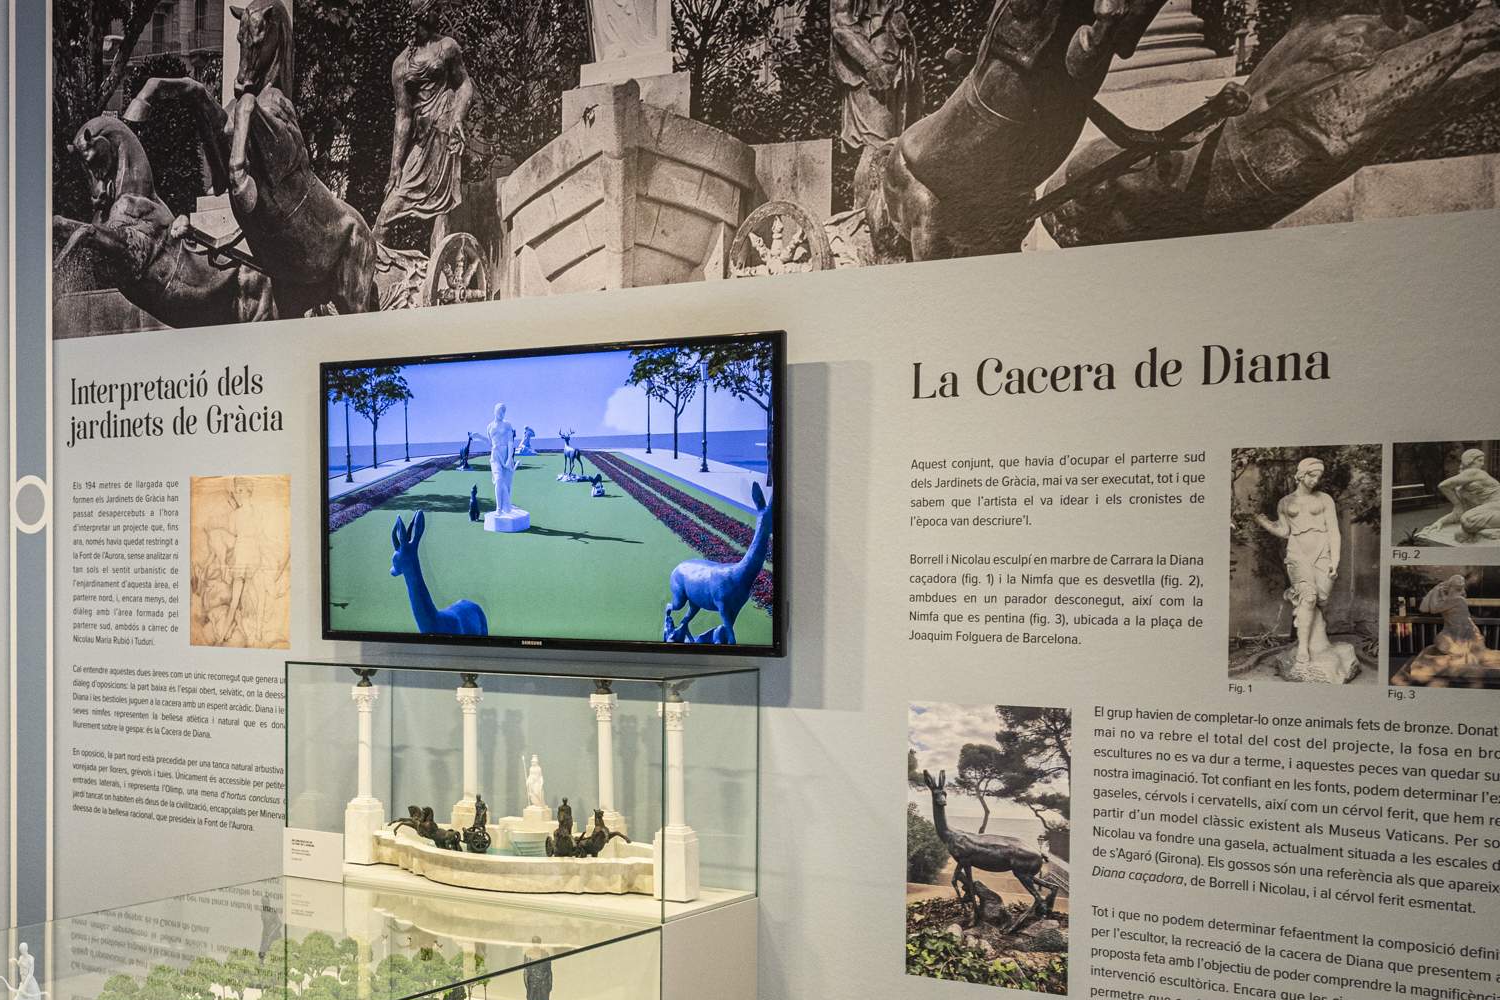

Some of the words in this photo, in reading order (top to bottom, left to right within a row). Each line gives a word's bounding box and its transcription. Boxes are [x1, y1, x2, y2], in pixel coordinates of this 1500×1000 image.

[911, 362, 960, 400] La
[976, 357, 1117, 397] Cacera
[1134, 346, 1183, 391] de
[1201, 344, 1331, 386] Diana
[71, 369, 208, 411] Interpretació
[217, 364, 263, 397] dels
[66, 409, 164, 448] jardinets
[172, 405, 198, 436] de
[206, 404, 284, 435] Gràcia
[911, 459, 947, 472] Aquest
[951, 457, 994, 471] conjunt,
[999, 458, 1020, 470] que
[1024, 455, 1054, 467] havia
[1114, 453, 1125, 464] el
[1130, 453, 1179, 466] parterre
[1184, 451, 1206, 463] sud
[910, 477, 932, 489] dels
[934, 477, 983, 488] Jardinets
[985, 476, 999, 487] de
[1001, 475, 1040, 488] Gràcia,
[1042, 475, 1063, 486] mai
[1065, 477, 1078, 486] va
[1081, 476, 1099, 485] ser
[1101, 473, 1154, 485] executat,
[1157, 473, 1173, 484] tot
[1175, 471, 1180, 484] i
[1182, 474, 1206, 486] que
[910, 497, 945, 508] sabem
[951, 498, 971, 509] que
[1024, 495, 1034, 506] el
[1040, 497, 1053, 506] va
[1060, 495, 1089, 506] idear
[1095, 493, 1099, 505] i
[1105, 493, 1122, 505] els
[1129, 493, 1182, 504] cronistes
[1189, 492, 1205, 504] de
[950, 517, 969, 526] van
[909, 553, 944, 565] Borrell
[945, 553, 950, 565] i
[951, 554, 991, 565] Nicolau
[993, 553, 1032, 567] esculpí
[1033, 556, 1047, 565] en
[1050, 554, 1091, 565] marbre
[1093, 554, 1108, 566] de
[1110, 554, 1154, 566] Carrara
[1156, 554, 1167, 566] la
[1169, 554, 1204, 566] Diana
[1392, 549, 1411, 561] Fig.
[1412, 548, 1421, 560] 2
[909, 573, 957, 586] caçadora
[962, 573, 981, 587] (fig.
[986, 573, 994, 586] 1)
[998, 573, 1003, 585] i
[1007, 574, 1016, 584] la
[1021, 573, 1053, 585] Nimfa
[1058, 576, 1080, 587] que
[1085, 576, 1098, 585] es
[1103, 574, 1155, 586] desvetlla
[1161, 574, 1183, 589] (fig.
[1188, 575, 1203, 589] 2),
[908, 629, 953, 643] Joaquim
[955, 630, 1003, 645] Folguera
[1005, 632, 1020, 643] de
[1022, 632, 1082, 645] Barcelona.
[1228, 683, 1245, 695] Fig.
[1247, 683, 1253, 694] 1
[1388, 689, 1408, 700] Fig.
[1409, 689, 1416, 700] 3
[1094, 705, 1104, 717] El
[1106, 709, 1133, 721] grup
[1136, 707, 1174, 721] havien
[1176, 710, 1192, 722] de
[1194, 712, 1269, 726] completar-lo
[1271, 717, 1302, 727] onze
[1305, 716, 1354, 730] animals
[1356, 718, 1381, 731] fets
[1383, 719, 1401, 732] de
[1404, 720, 1453, 735] bronze.
[1457, 723, 1499, 737] Donat
[1091, 865, 1126, 879] Diana
[1128, 871, 1187, 887] caçadora,
[1190, 875, 1206, 887] de
[1209, 876, 1249, 891] Borrell
[1251, 879, 1257, 893] i
[1259, 881, 1310, 899] Nicolau,
[1312, 885, 1318, 899] i
[1320, 888, 1332, 900] al
[1335, 889, 1375, 904] cérvol
[1378, 892, 1405, 907] ferit
[1408, 898, 1476, 914] esmentat.
